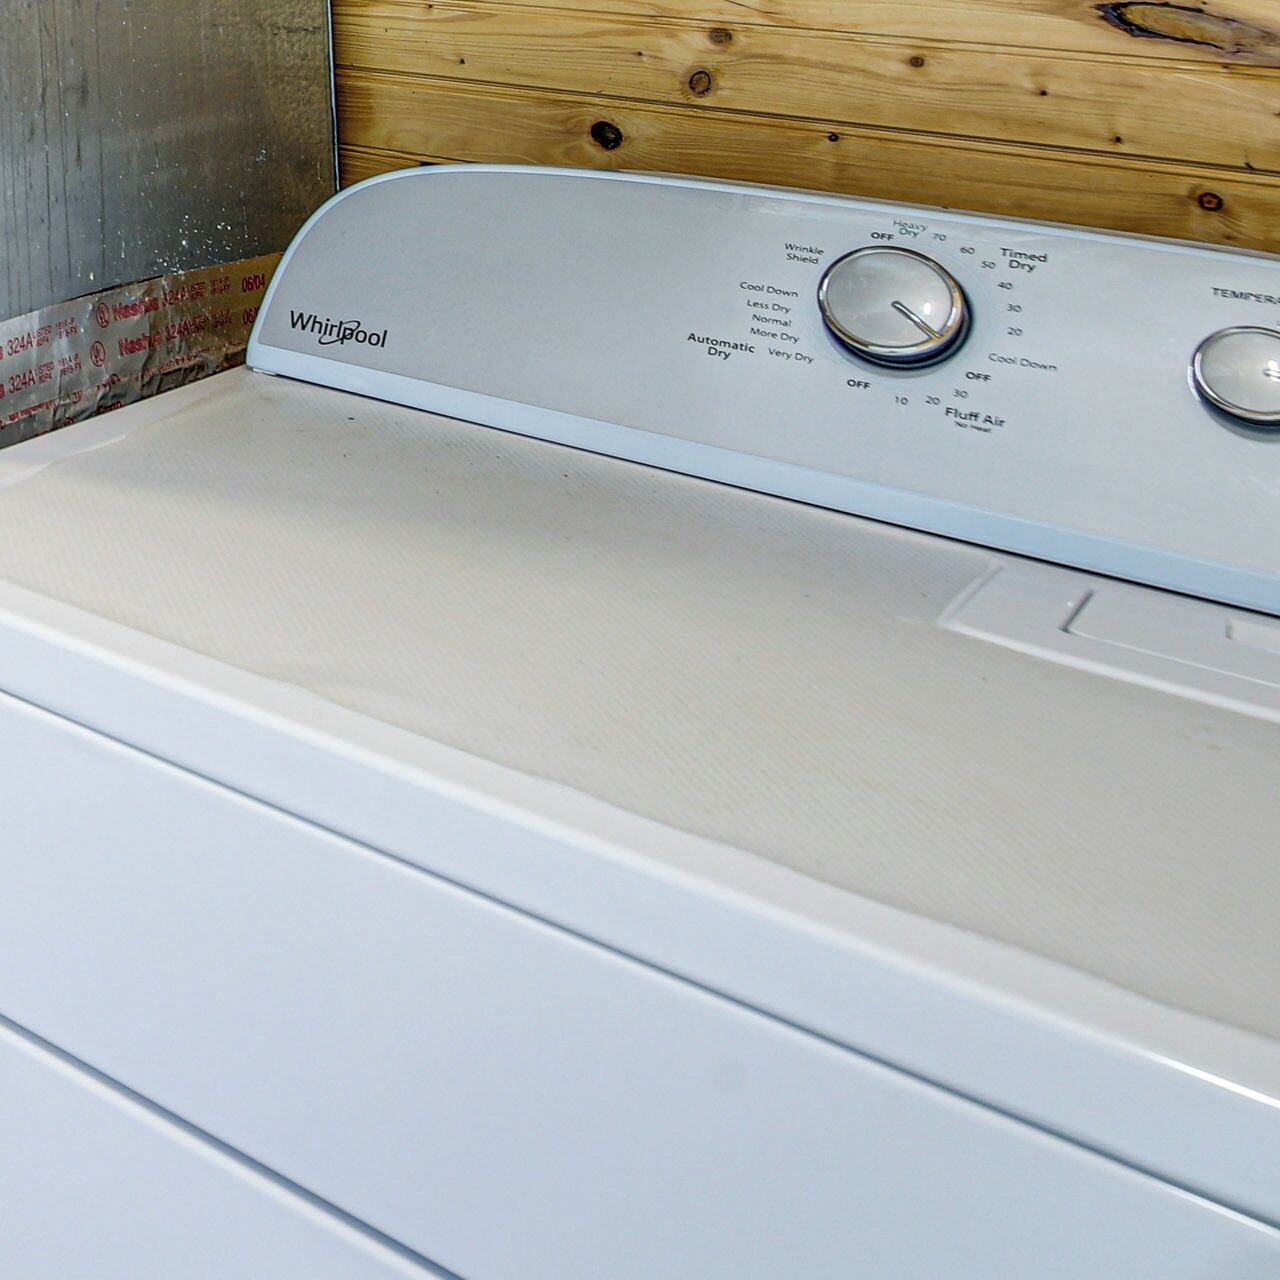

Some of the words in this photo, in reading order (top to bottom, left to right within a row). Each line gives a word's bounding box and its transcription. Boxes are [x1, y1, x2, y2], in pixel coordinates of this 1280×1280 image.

[871, 231, 894, 241] OFF
[932, 233, 947, 242] 70
[784, 242, 825, 256] Wrinkle
[960, 246, 975, 255] 60
[1000, 247, 1048, 263] Timed
[786, 253, 819, 265] Shield
[981, 261, 996, 270] 50
[1008, 260, 1036, 273] Dry
[740, 281, 765, 292] Cool
[766, 286, 799, 298] Down
[997, 282, 1014, 290] 40
[112, 296, 160, 321] Nashua
[242, 273, 266, 293] 06/04
[747, 299, 769, 310] Less
[772, 303, 791, 314] Dry
[1007, 304, 1023, 313] 30
[752, 314, 792, 327] Normal
[118, 331, 161, 357] Nashua
[243, 307, 258, 325] 06/
[290, 310, 388, 348] Whirlpool
[750, 327, 778, 339] More
[780, 332, 800, 344] Dry
[1007, 327, 1023, 336] 20
[7, 332, 33, 356] 324A
[687, 332, 756, 354] Automatic
[707, 346, 731, 360] Dry
[768, 347, 792, 359] Very
[795, 353, 814, 364] Dry
[989, 353, 1017, 366] Cool
[1019, 358, 1058, 371] Down
[9, 369, 36, 394] 324A
[965, 371, 991, 382] OFF
[847, 379, 871, 390] OFF
[894, 396, 909, 405] 10
[925, 396, 941, 405] 20
[953, 389, 969, 399] 30
[945, 407, 979, 422] Fluff
[982, 414, 1005, 427] Air
